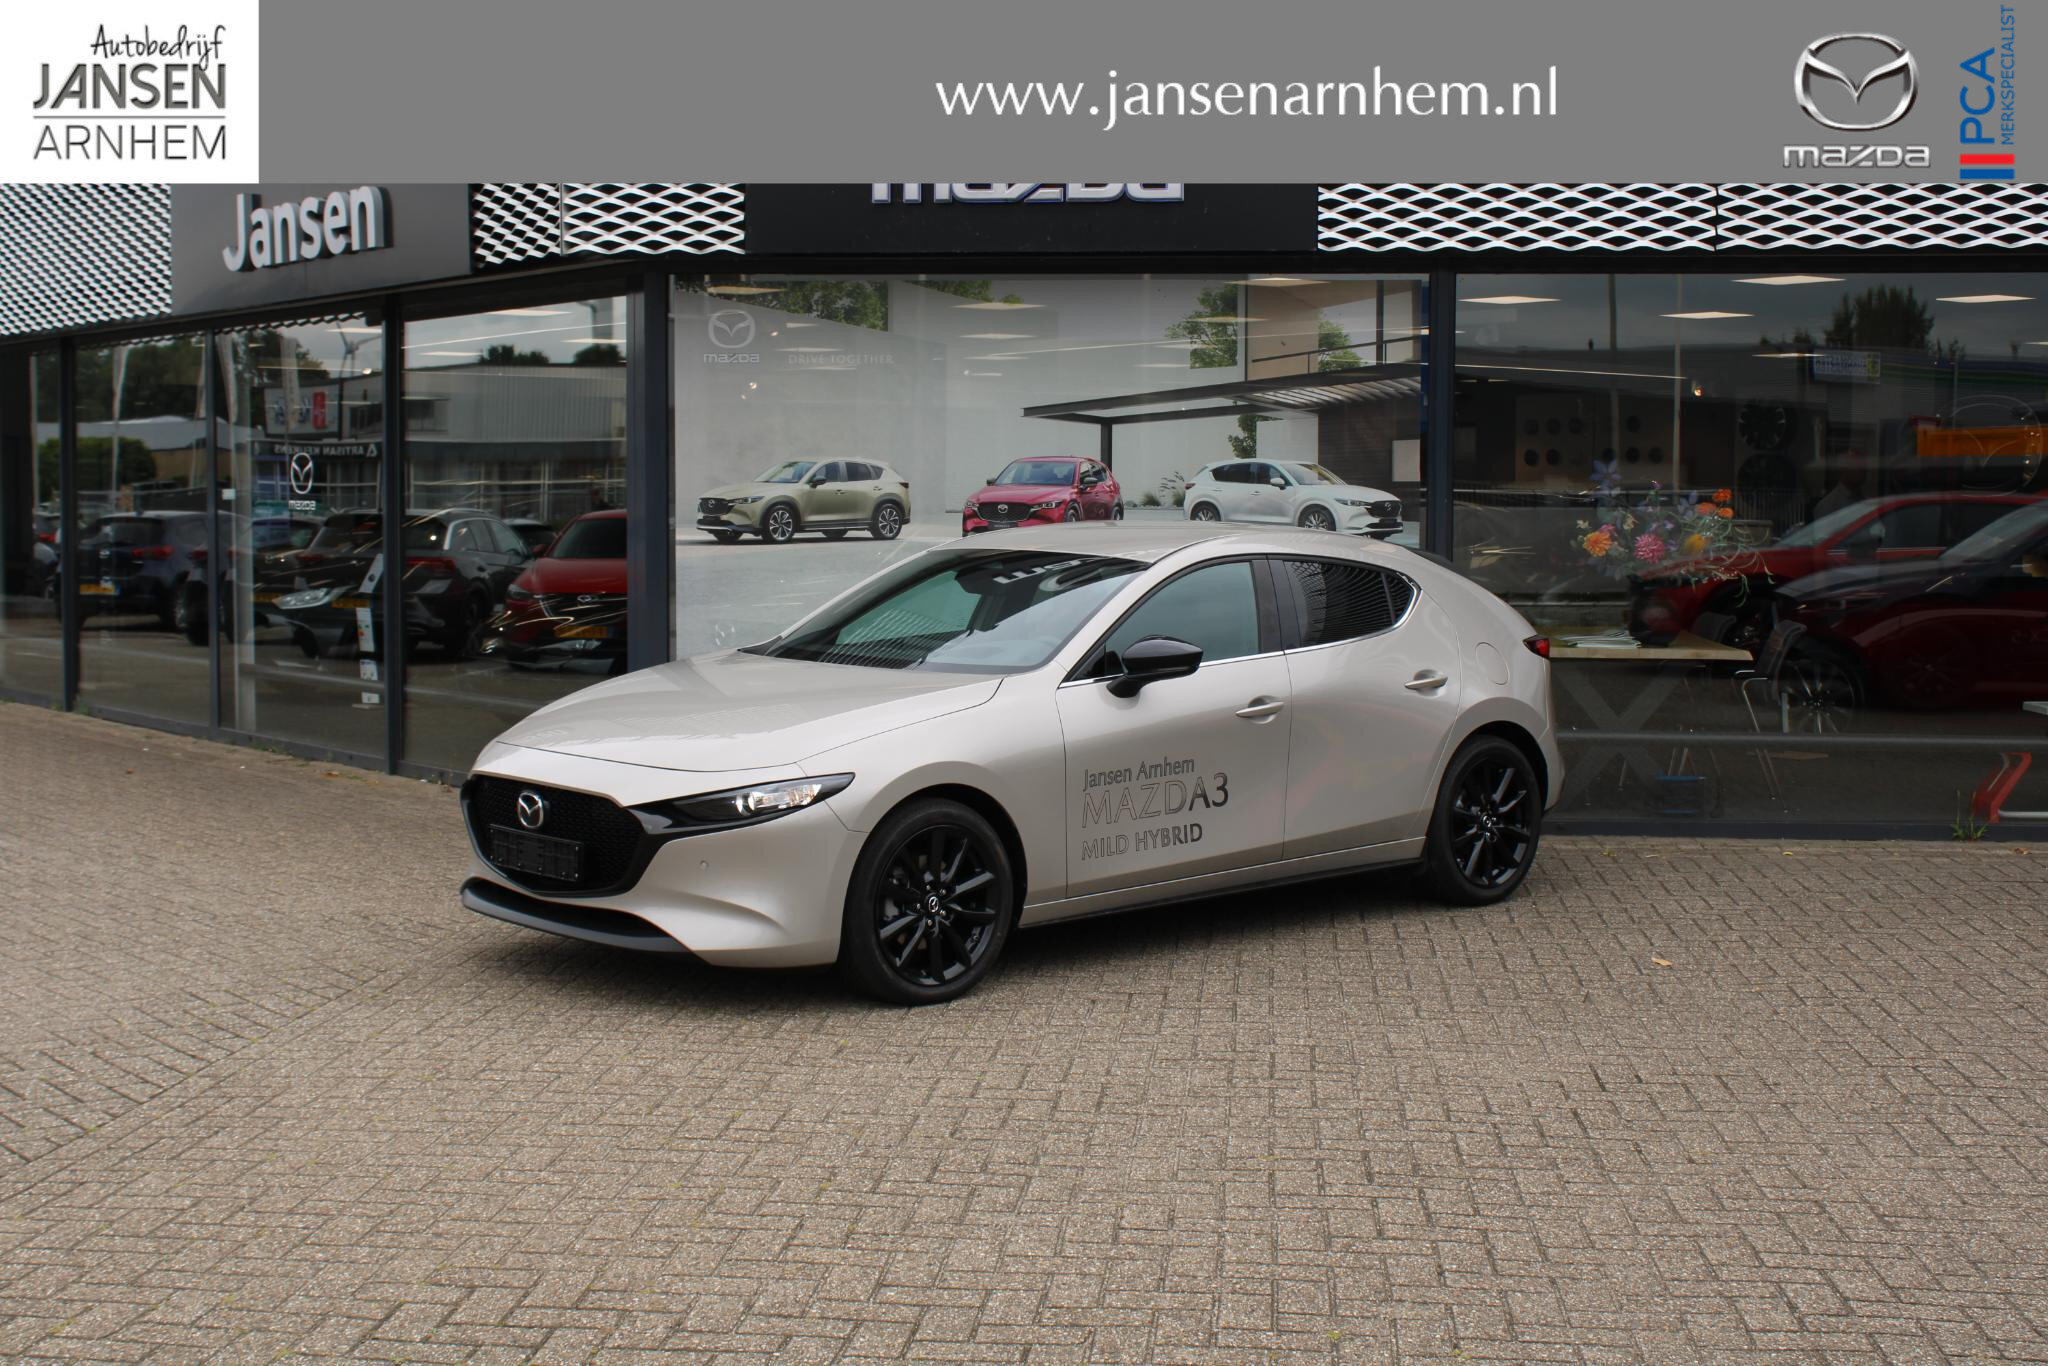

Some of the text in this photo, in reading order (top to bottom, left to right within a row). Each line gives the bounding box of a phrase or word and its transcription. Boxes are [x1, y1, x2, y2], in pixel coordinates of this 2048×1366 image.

[222, 185, 385, 272] Jansen
[788, 353, 895, 365] DRIVE TOGETHER
[1082, 756, 1195, 792] Jansen Arnhem
[1082, 772, 1230, 829] MAZDA3
[1081, 822, 1203, 861] MILD HYBRID
